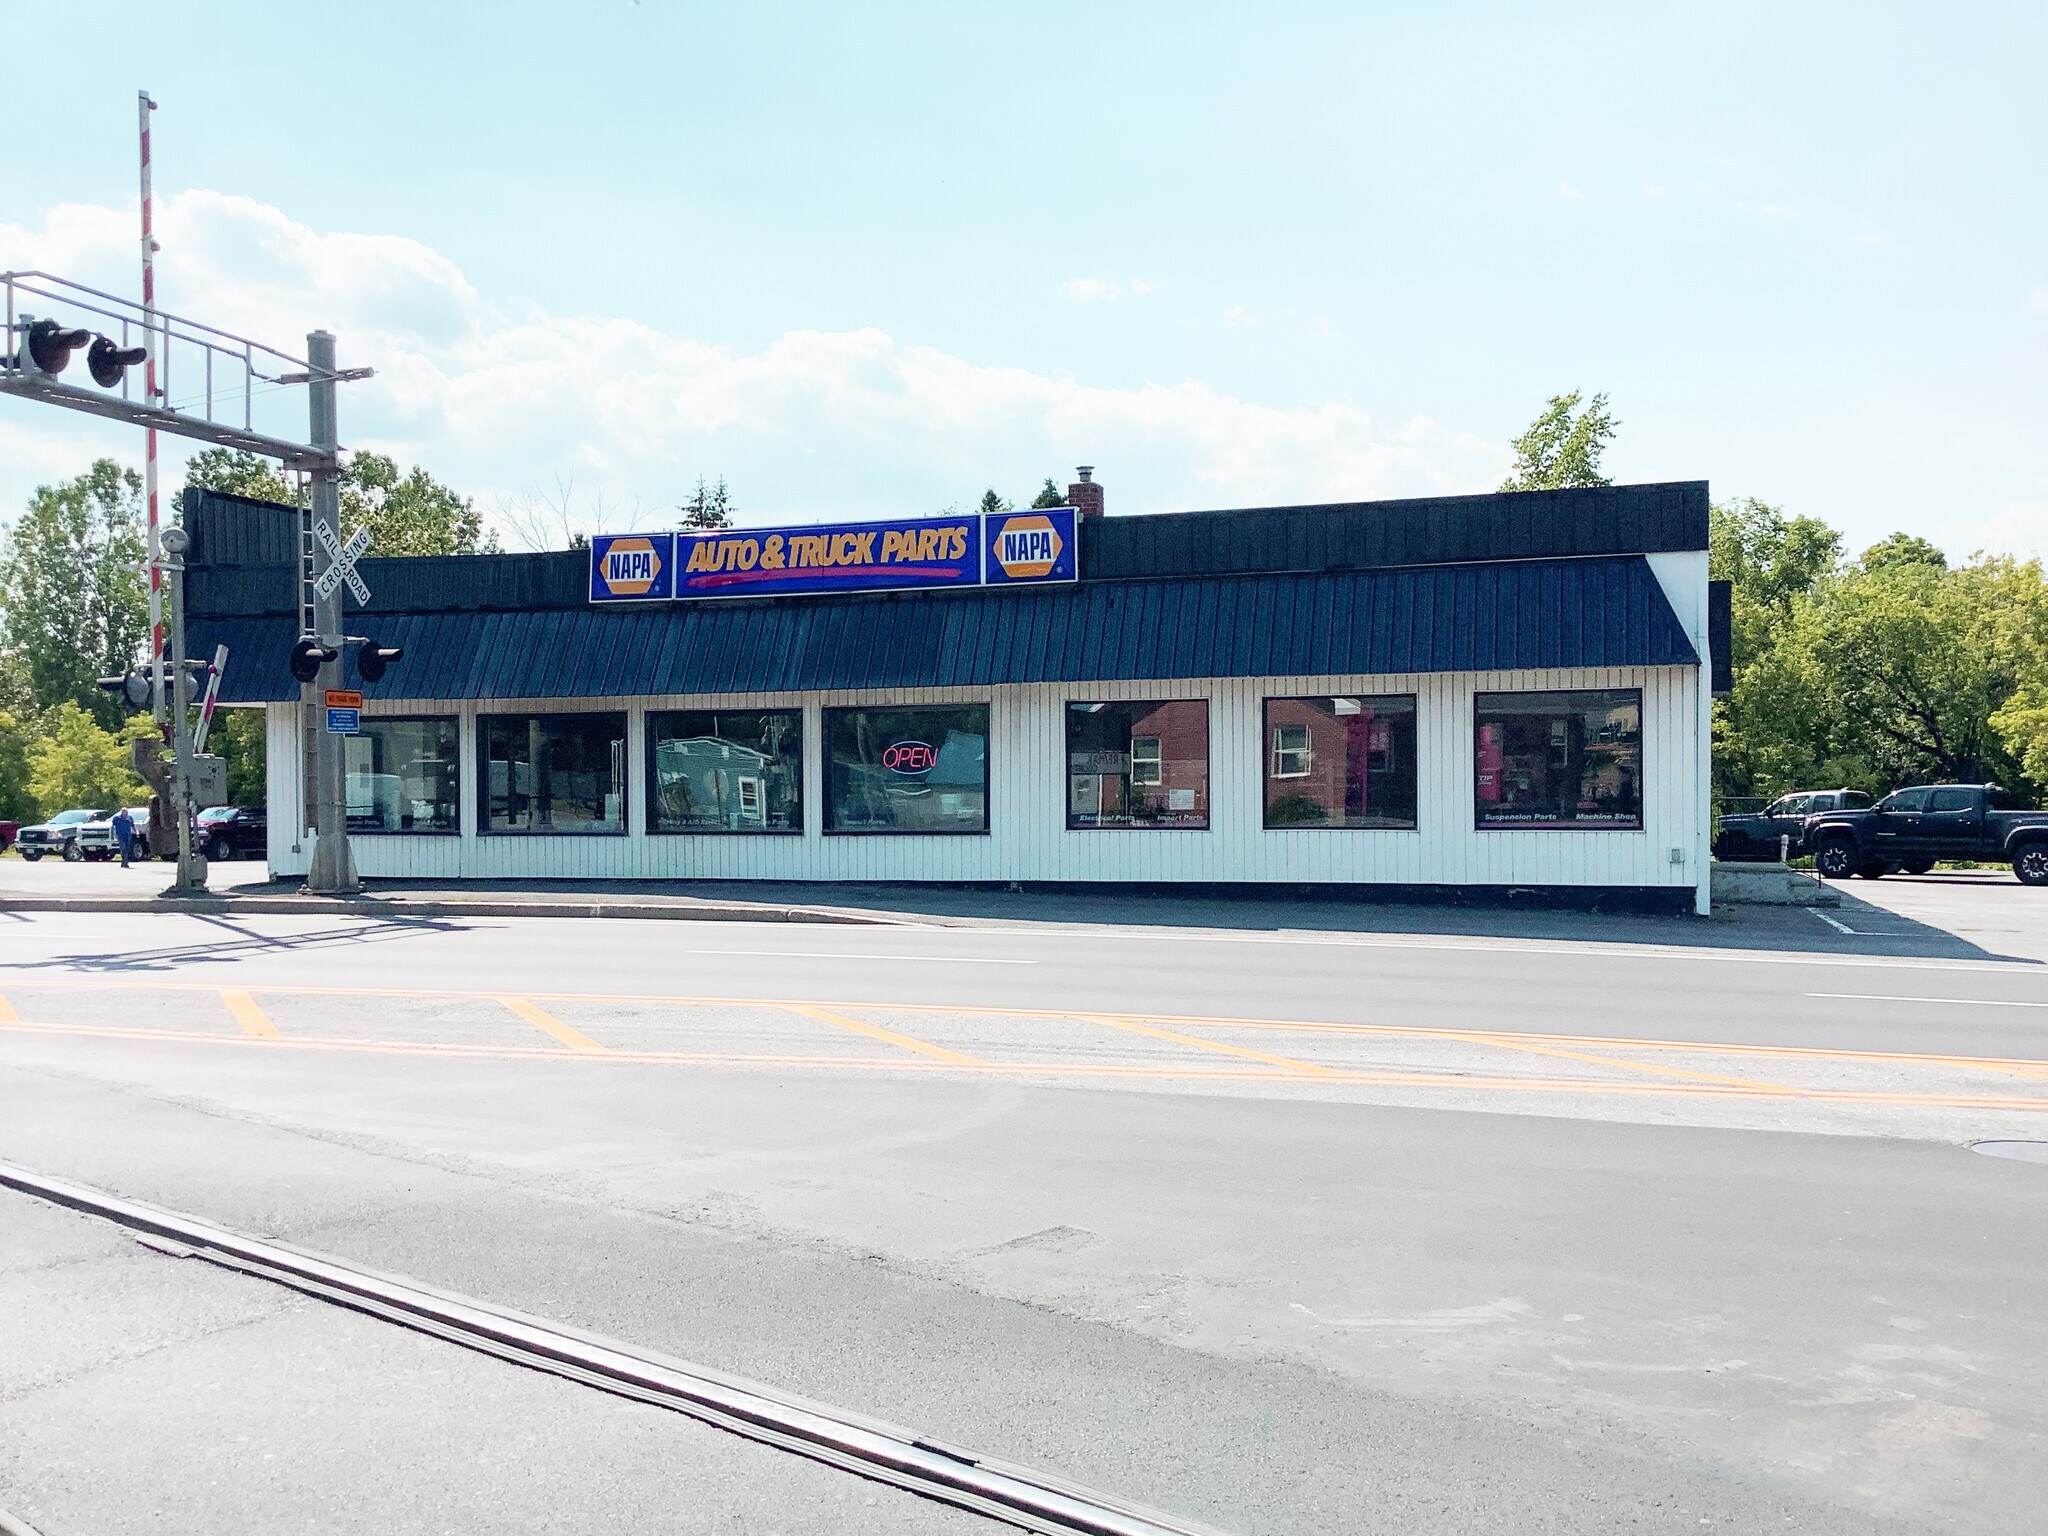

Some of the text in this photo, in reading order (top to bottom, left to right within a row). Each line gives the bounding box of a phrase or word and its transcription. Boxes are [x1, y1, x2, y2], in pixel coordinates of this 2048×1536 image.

[788, 531, 877, 568] TRUCK
[880, 526, 968, 563] PARTS
[1005, 532, 1051, 561] NAPA
[317, 522, 368, 602] RAIL ROAD
[321, 532, 368, 594] CROSSING
[609, 553, 651, 580] NAPA
[883, 747, 939, 768] OPEN
[1484, 813, 1532, 821] Suspension
[1614, 813, 1636, 821] Shop
